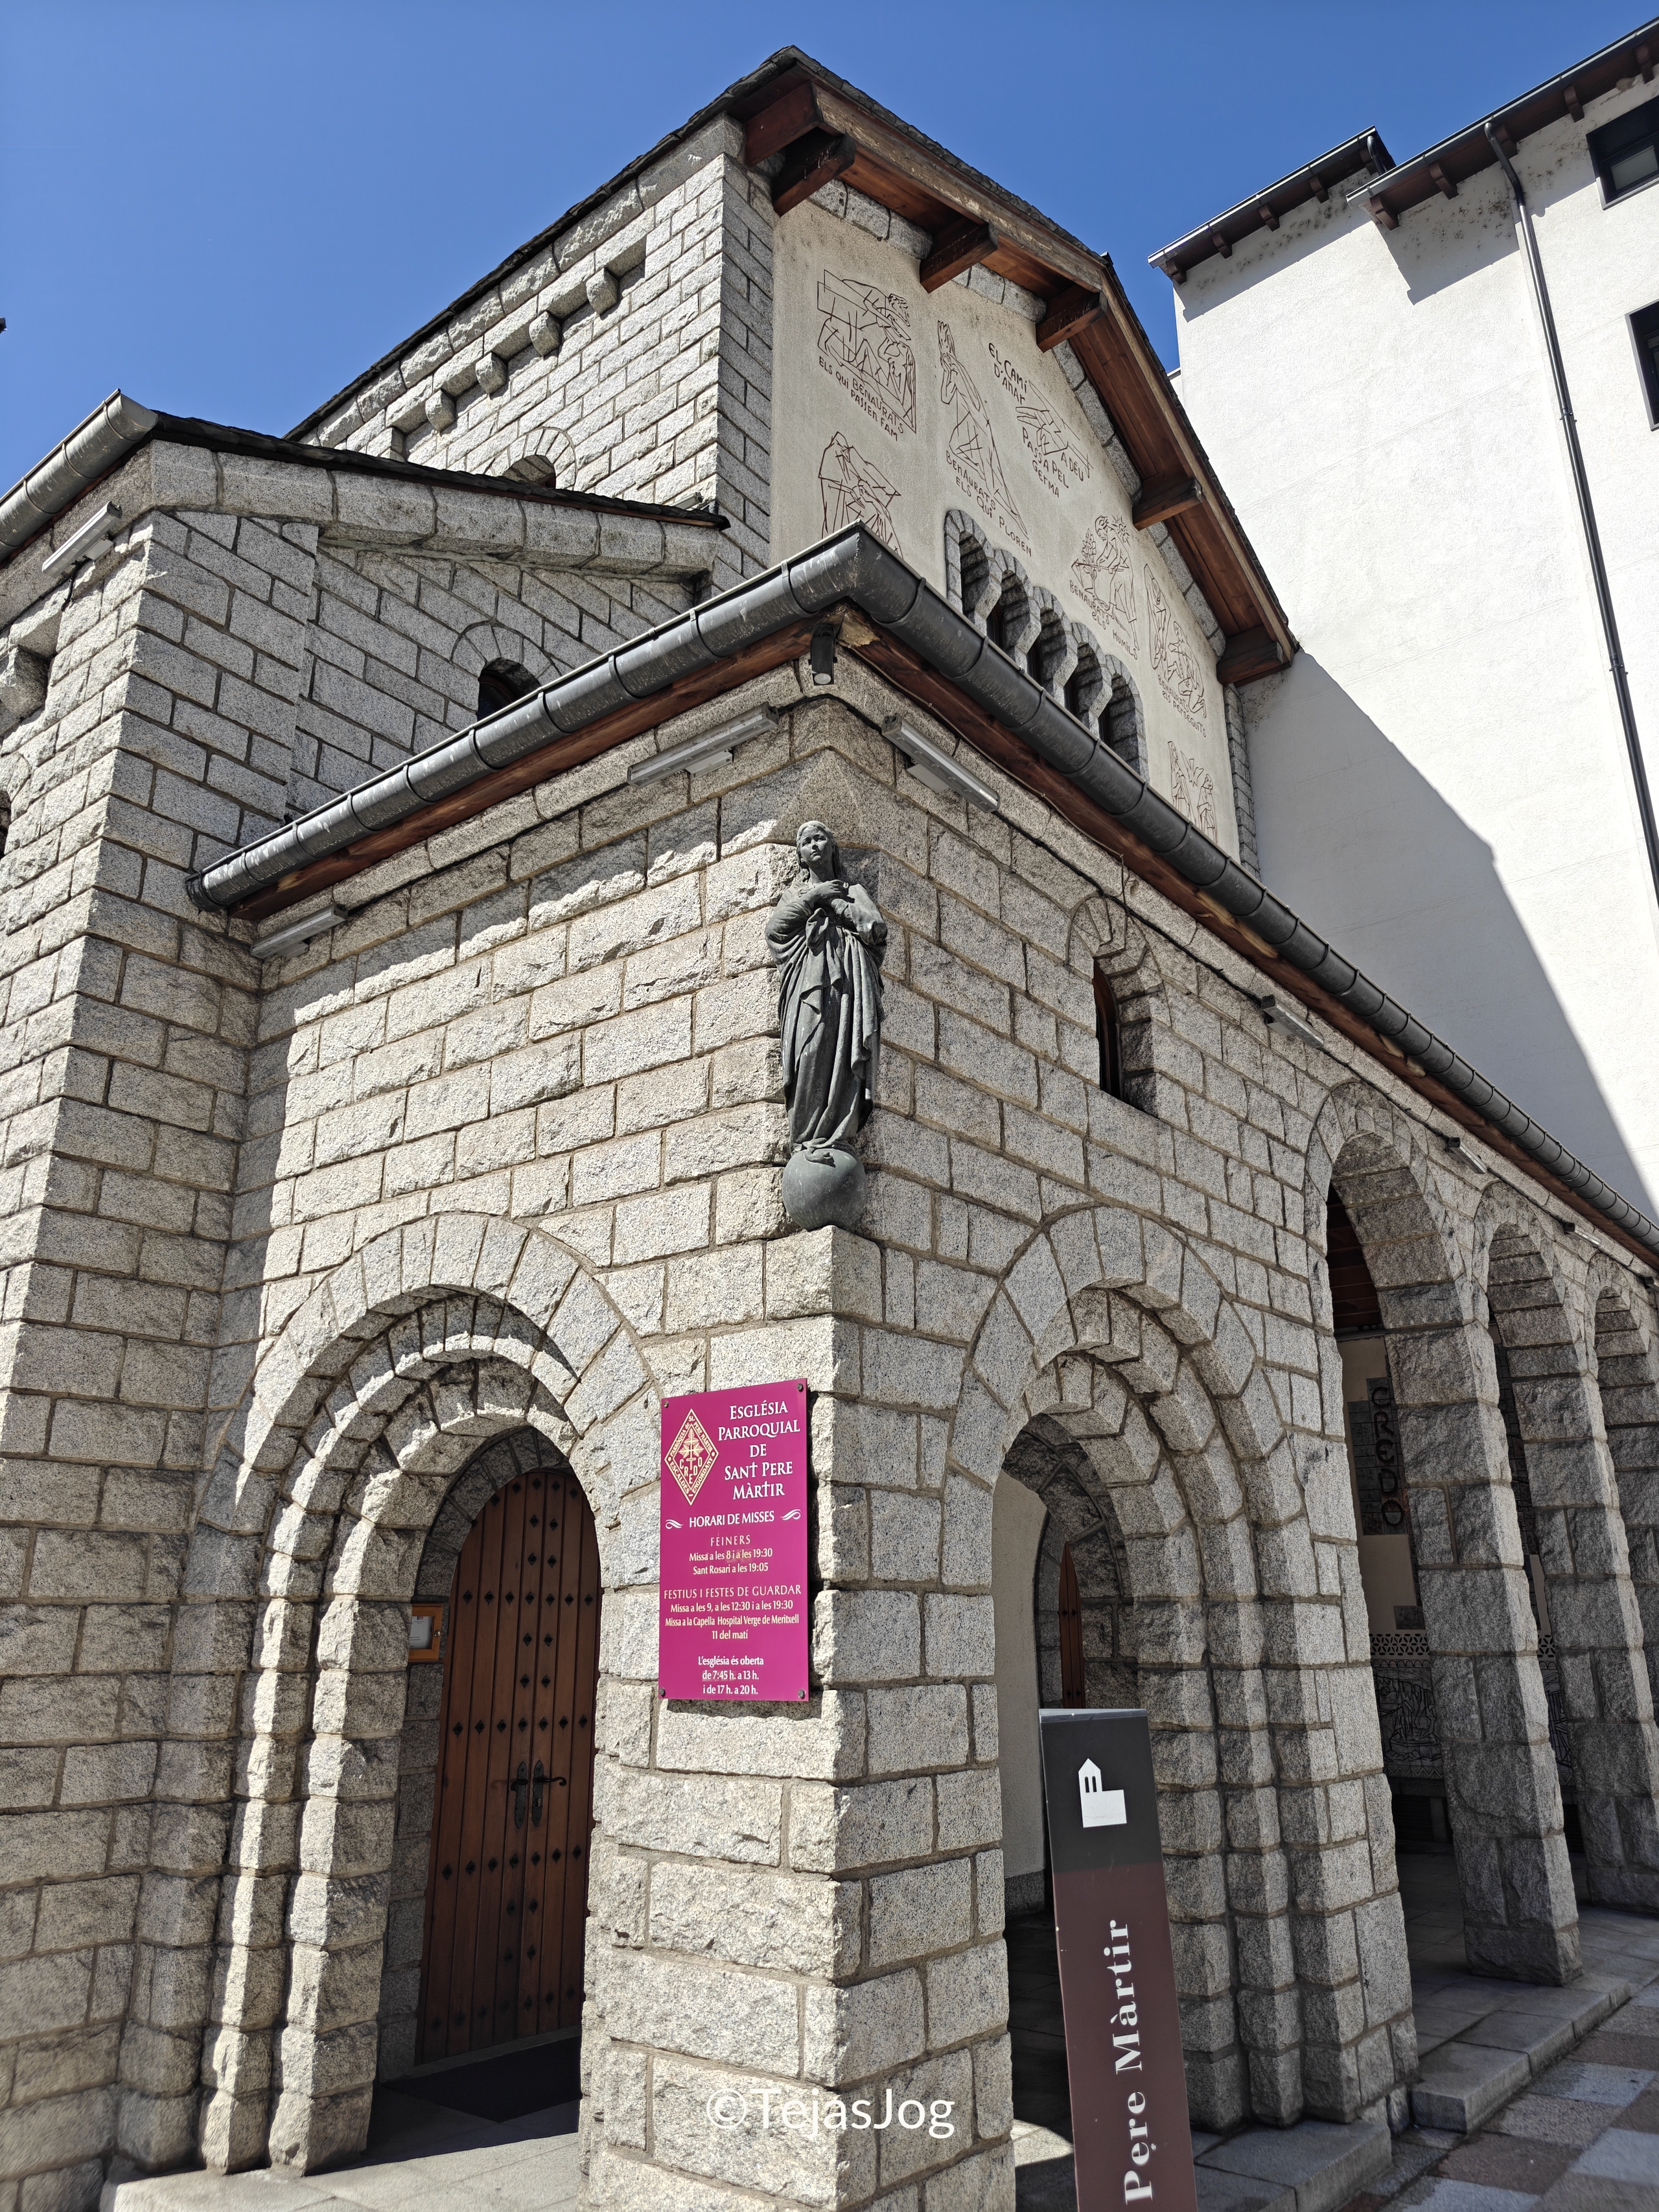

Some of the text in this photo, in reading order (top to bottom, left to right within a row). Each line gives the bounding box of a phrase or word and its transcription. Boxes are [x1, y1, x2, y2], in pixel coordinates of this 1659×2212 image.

[989, 343, 1002, 366] EL
[819, 356, 832, 375] ELS
[881, 417, 898, 441] FAM
[852, 378, 903, 434] BENAURATS
[1061, 452, 1067, 467] A
[1052, 460, 1069, 489] PEL
[956, 476, 971, 497] ELS
[999, 516, 1032, 557] PLOREN
[750, 1444, 767, 1457] DE
[1371, 1386, 1404, 1526] CREDO
[669, 1457, 713, 1494] ESCALDES ENGORDANY
[680, 1457, 702, 1484] CREDO
[690, 1510, 774, 1528] HORARI DE MISSES
[710, 1535, 750, 1546] FEINERS
[689, 1552, 708, 1561] Missa
[715, 1550, 725, 1560] les
[726, 1550, 731, 1559] 8
[732, 1550, 735, 1559] i
[742, 1549, 752, 1559] les
[753, 1548, 773, 1558] 19:30
[693, 1566, 708, 1575] Sant
[710, 1564, 730, 1574] Rosari
[737, 1563, 747, 1573] les
[748, 1563, 769, 1572] 19:05
[664, 1584, 802, 1600] FESTIUS I FESTES DE GUARDAR
[670, 1603, 690, 1612] Missa
[696, 1602, 706, 1612] les
[706, 1602, 713, 1613] 9,
[721, 1601, 730, 1611] les
[731, 1601, 750, 1611] 12:30
[752, 1601, 754, 1610] i
[761, 1600, 772, 1610] les
[772, 1600, 793, 1609] 19:30
[665, 1618, 681, 1626] Missa
[687, 1616, 692, 1626] la
[693, 1616, 715, 1628] Capella
[717, 1615, 743, 1627] Hospital
[743, 1615, 761, 1627] Verge
[762, 1614, 770, 1624] de
[771, 1613, 799, 1624] Meritxell
[712, 1629, 748, 1640] 11 del matí
[698, 1655, 764, 1668] L'església és oberta
[702, 1670, 712, 1679] de
[713, 1670, 728, 1680] 7:45
[729, 1670, 736, 1680] h.
[743, 1670, 751, 1680] 13
[752, 1670, 760, 1680] h.
[703, 1684, 706, 1694] i
[706, 1684, 716, 1694] de
[717, 1684, 725, 1694] 17
[726, 1684, 733, 1694] h.
[739, 1685, 750, 1695] 20
[751, 1684, 758, 1695] h.
[1104, 1919, 1154, 2205] Pere Màrtir
